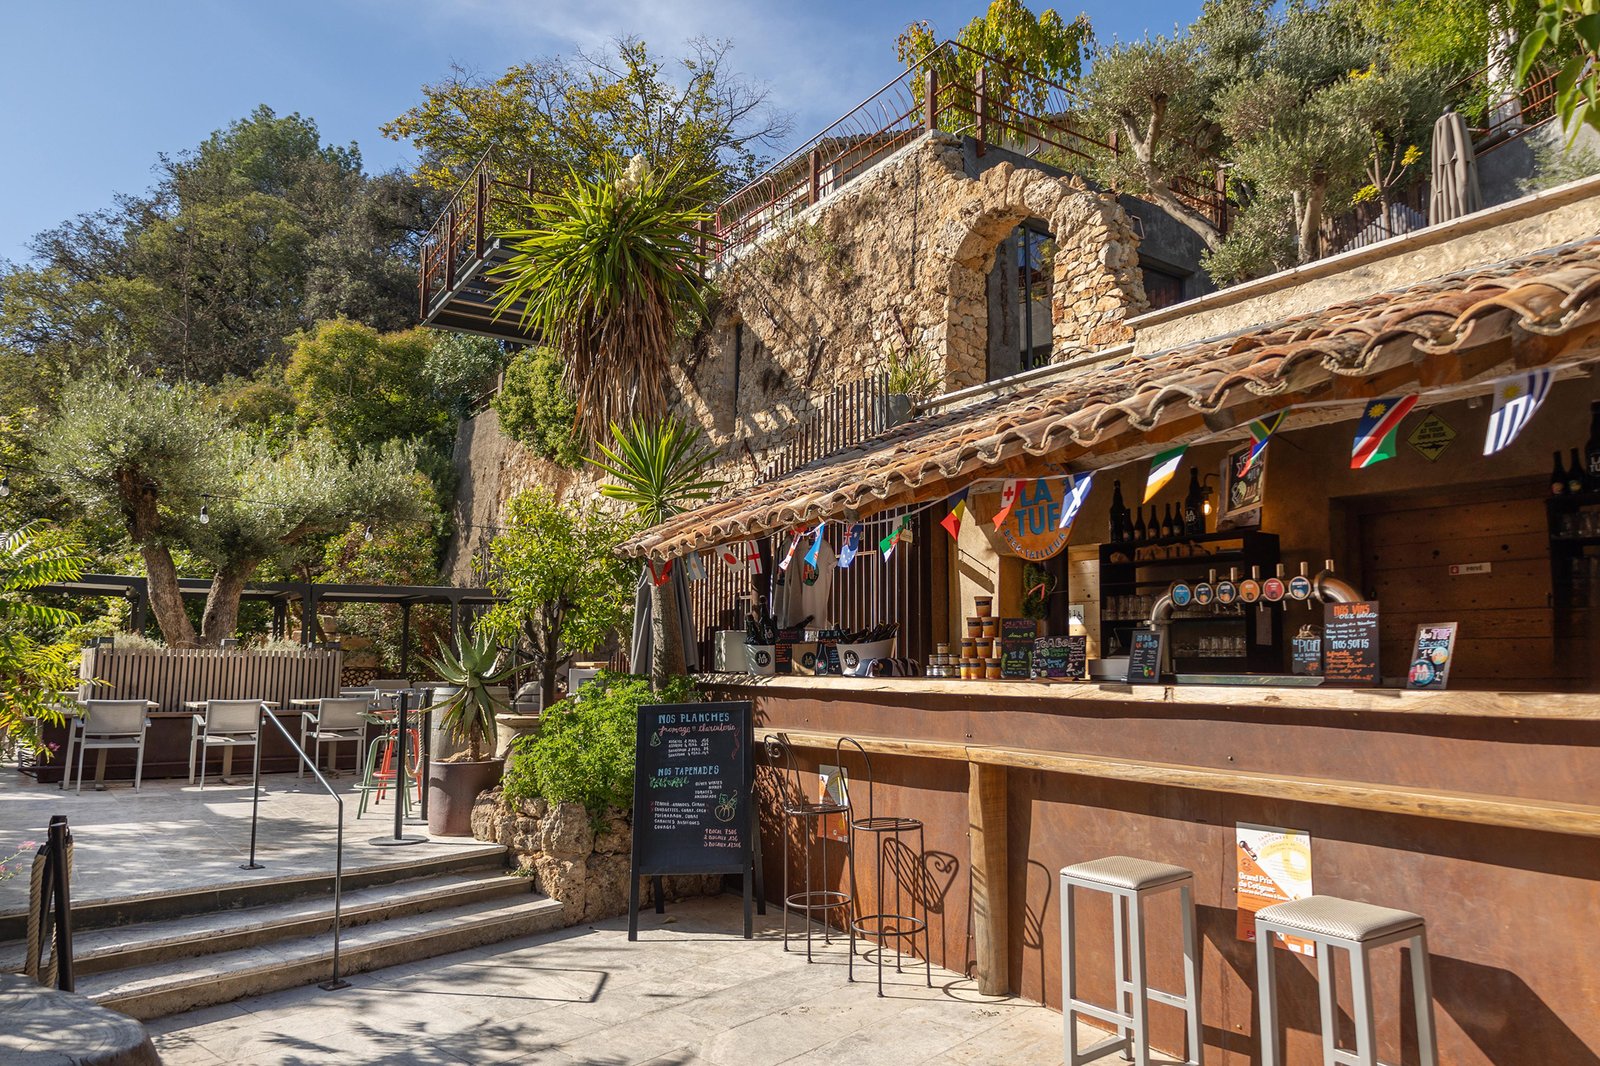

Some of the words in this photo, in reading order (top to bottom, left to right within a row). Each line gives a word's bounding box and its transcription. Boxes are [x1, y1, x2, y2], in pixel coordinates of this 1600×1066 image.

[1590, 464, 1600, 473] TU
[1020, 476, 1053, 508] LA
[1014, 501, 1060, 537] TUF
[1298, 639, 1322, 653] PICHET
[1332, 640, 1346, 650] NOS
[1416, 664, 1428, 672] LA
[1414, 672, 1430, 681] TUF
[658, 714, 676, 724] NOS
[680, 712, 730, 723] PLANCHES
[658, 725, 691, 736] fromage
[658, 768, 672, 776] NOS
[674, 765, 720, 776] TAPENADES
[1238, 872, 1259, 882] Grand
[1260, 876, 1274, 884] Prix
[1238, 880, 1248, 888] de
[1248, 881, 1276, 893] Cotignac
